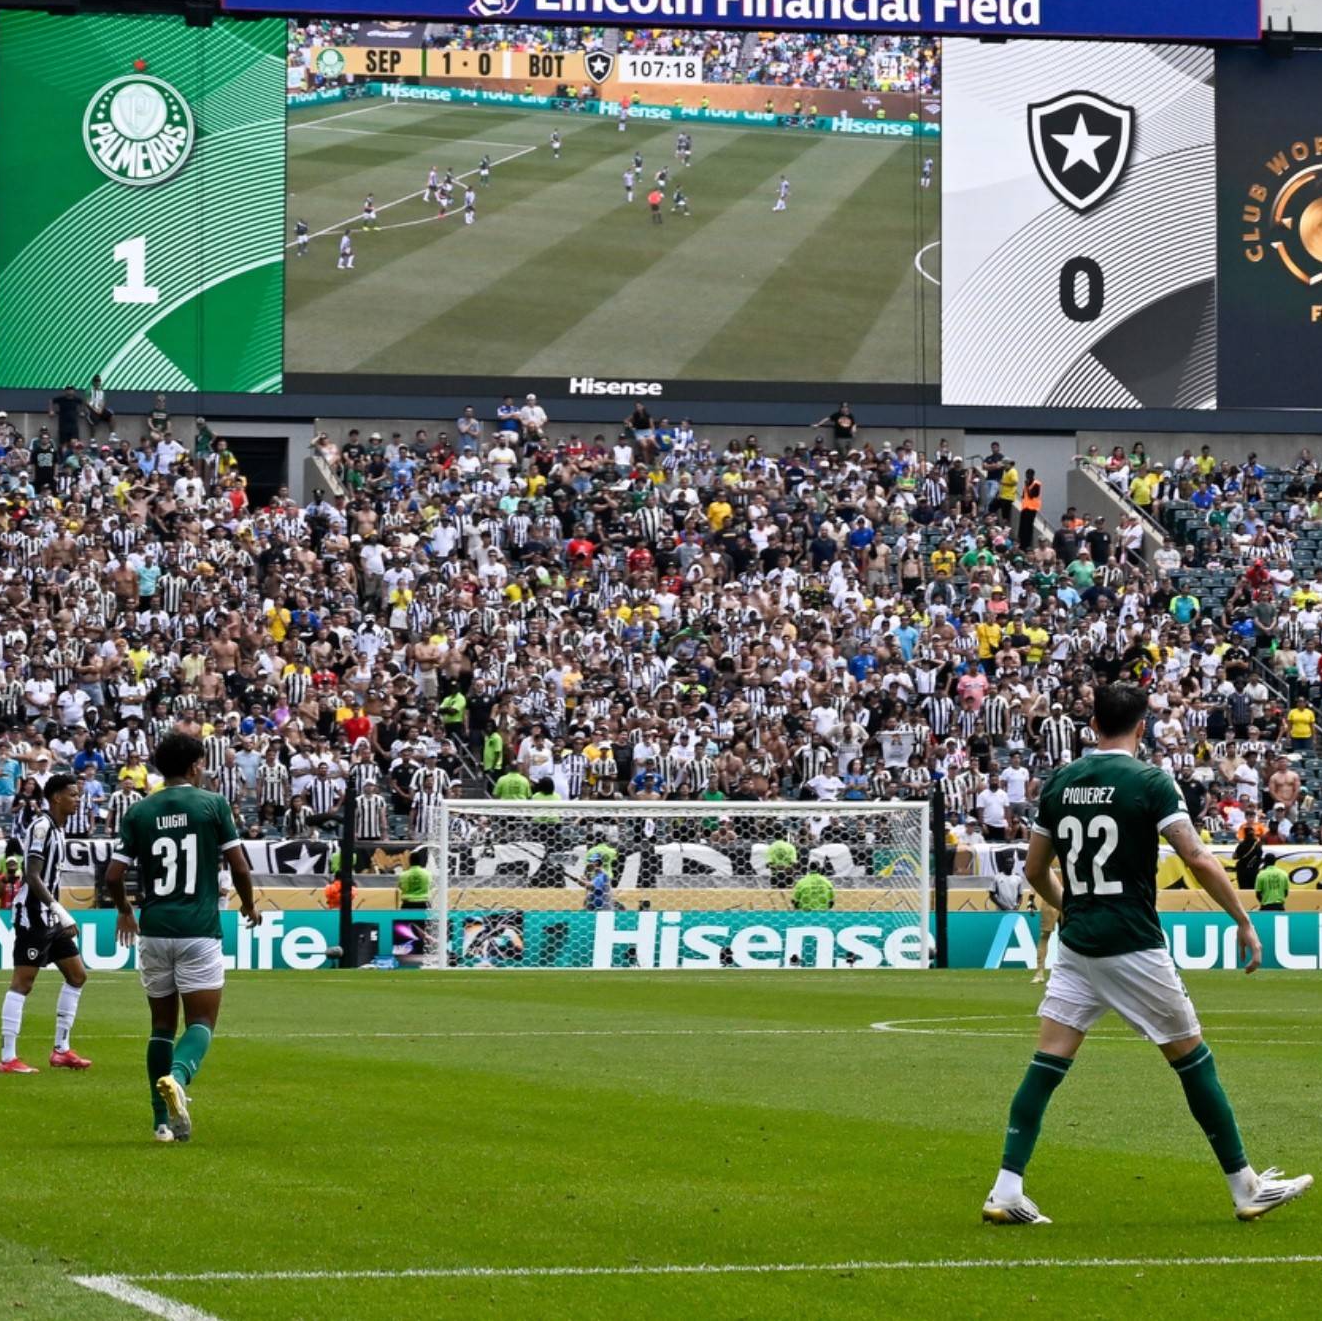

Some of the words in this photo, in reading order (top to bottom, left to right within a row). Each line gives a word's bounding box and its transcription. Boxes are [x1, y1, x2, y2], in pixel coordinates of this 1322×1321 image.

[366, 49, 401, 73] SEP
[442, 52, 451, 74] 1
[478, 53, 491, 76] 0
[529, 54, 565, 77] BOT
[629, 60, 696, 79] 107:18
[381, 82, 451, 102] Hisense
[599, 101, 671, 120] Hiense
[832, 116, 914, 136] Hisense
[89, 121, 188, 179] PALMEIRAS
[1242, 183, 1268, 263] CLUB
[113, 234, 159, 303] 1
[1060, 255, 1105, 323] 0
[569, 377, 663, 396] Hisense
[1062, 786, 1116, 804] PIQUEREZ
[156, 813, 188, 830] LUIGHI
[151, 833, 197, 896] 31
[1057, 814, 1123, 896] 22
[222, 910, 328, 970] ife
[592, 911, 935, 969] Hisense
